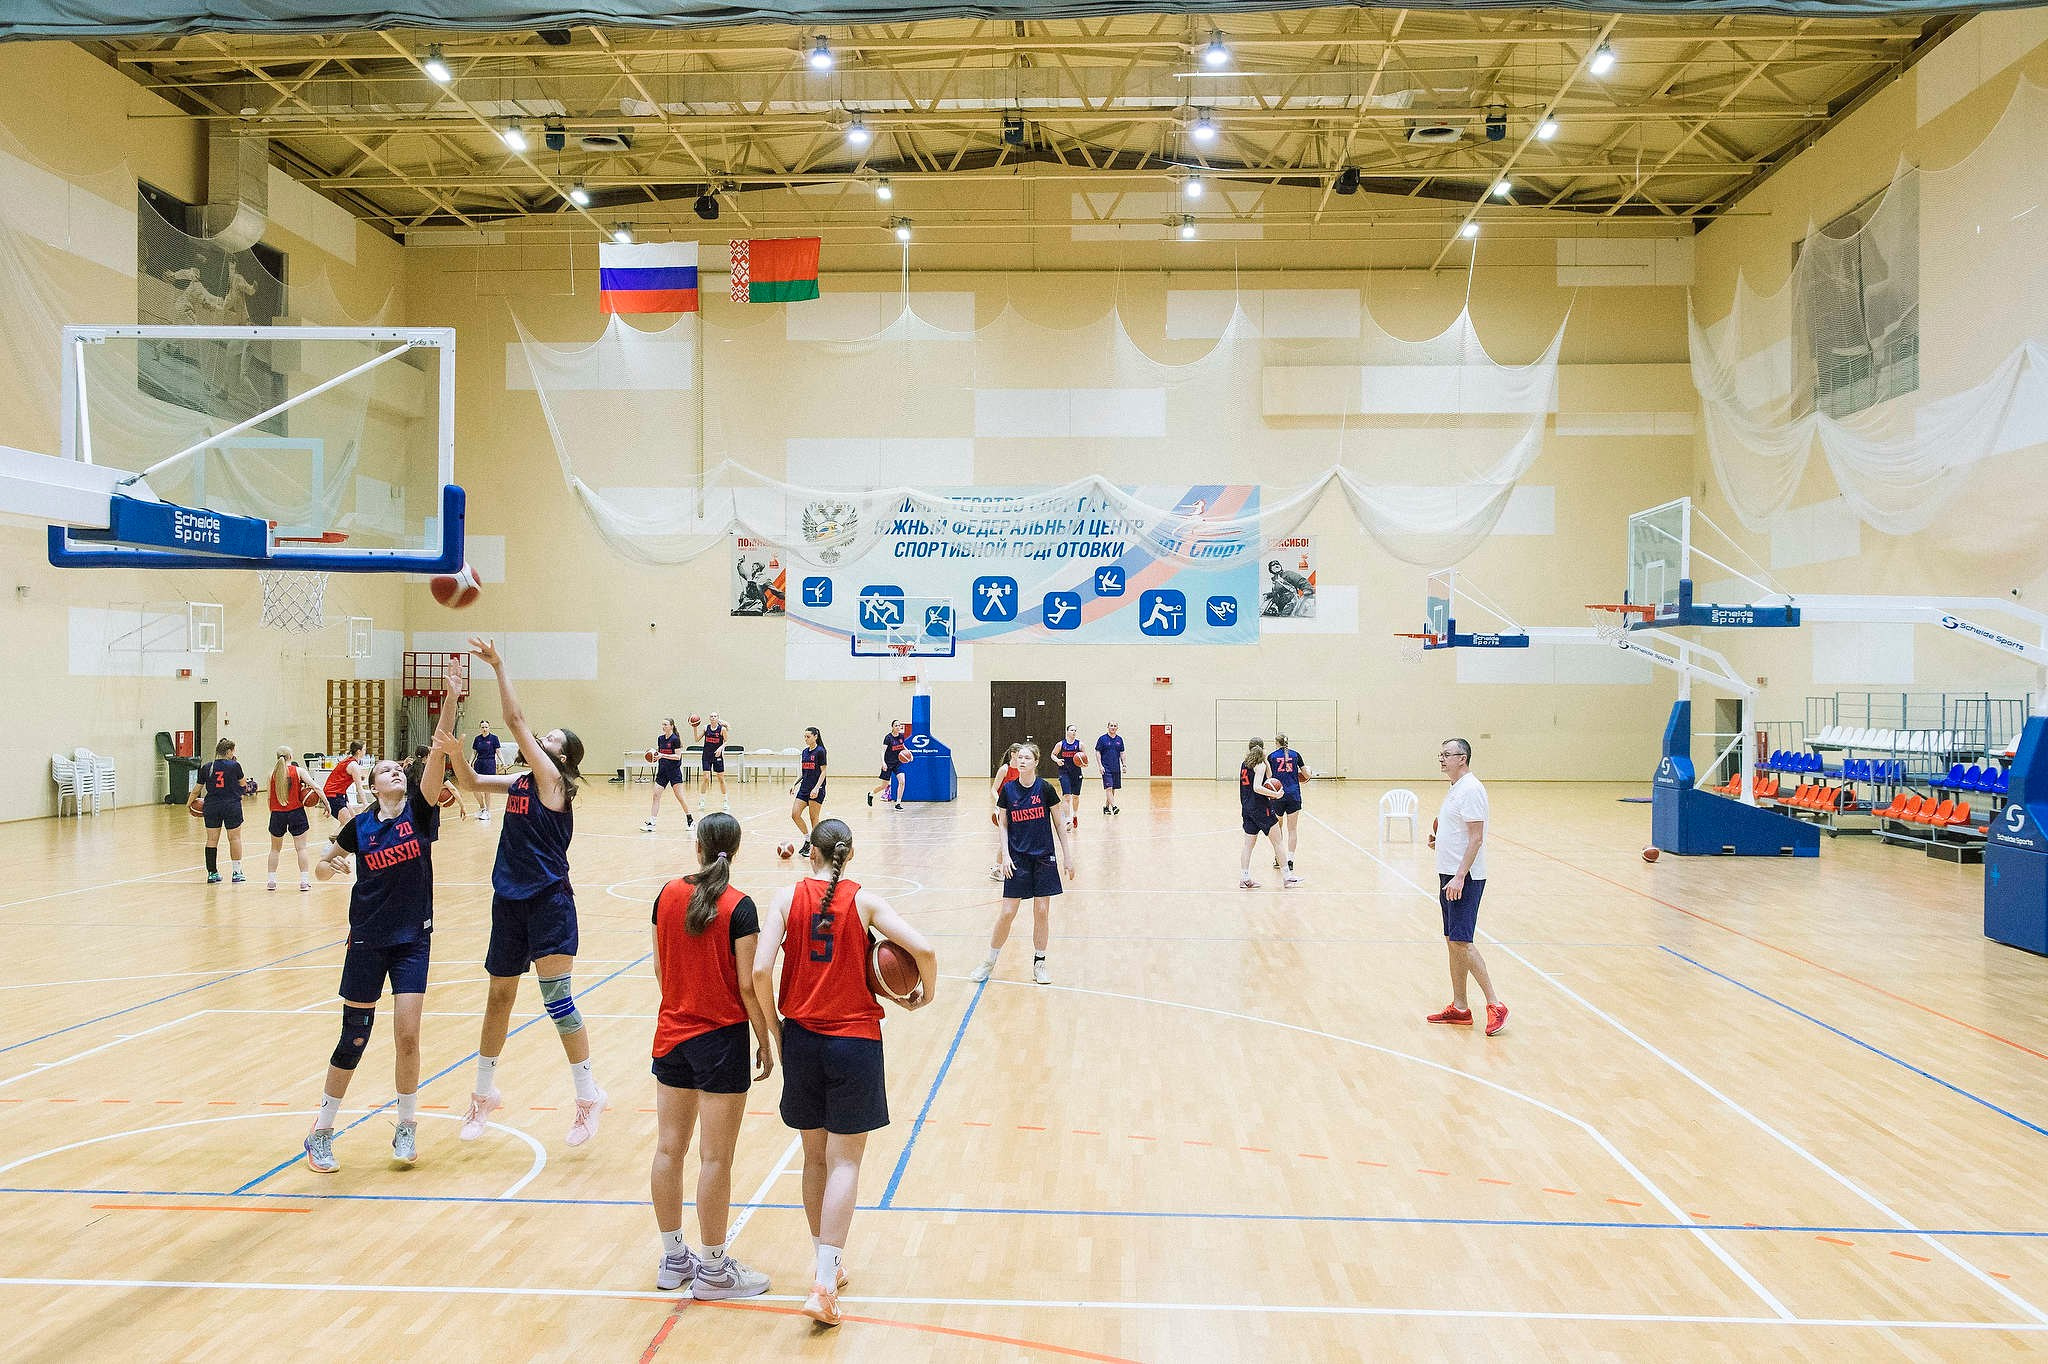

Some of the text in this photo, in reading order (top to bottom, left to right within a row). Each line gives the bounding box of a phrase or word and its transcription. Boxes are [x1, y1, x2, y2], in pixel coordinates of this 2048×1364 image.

[174, 510, 221, 530] Schelde
[174, 524, 221, 544] Sports
[1711, 616, 1754, 625] Sports
[1995, 635, 2025, 652] Sports
[215, 770, 225, 788] 3
[1011, 806, 1045, 823] RUSSIA
[395, 821, 415, 838] 20
[364, 839, 421, 871] RUSSIA
[810, 912, 835, 963] 5
